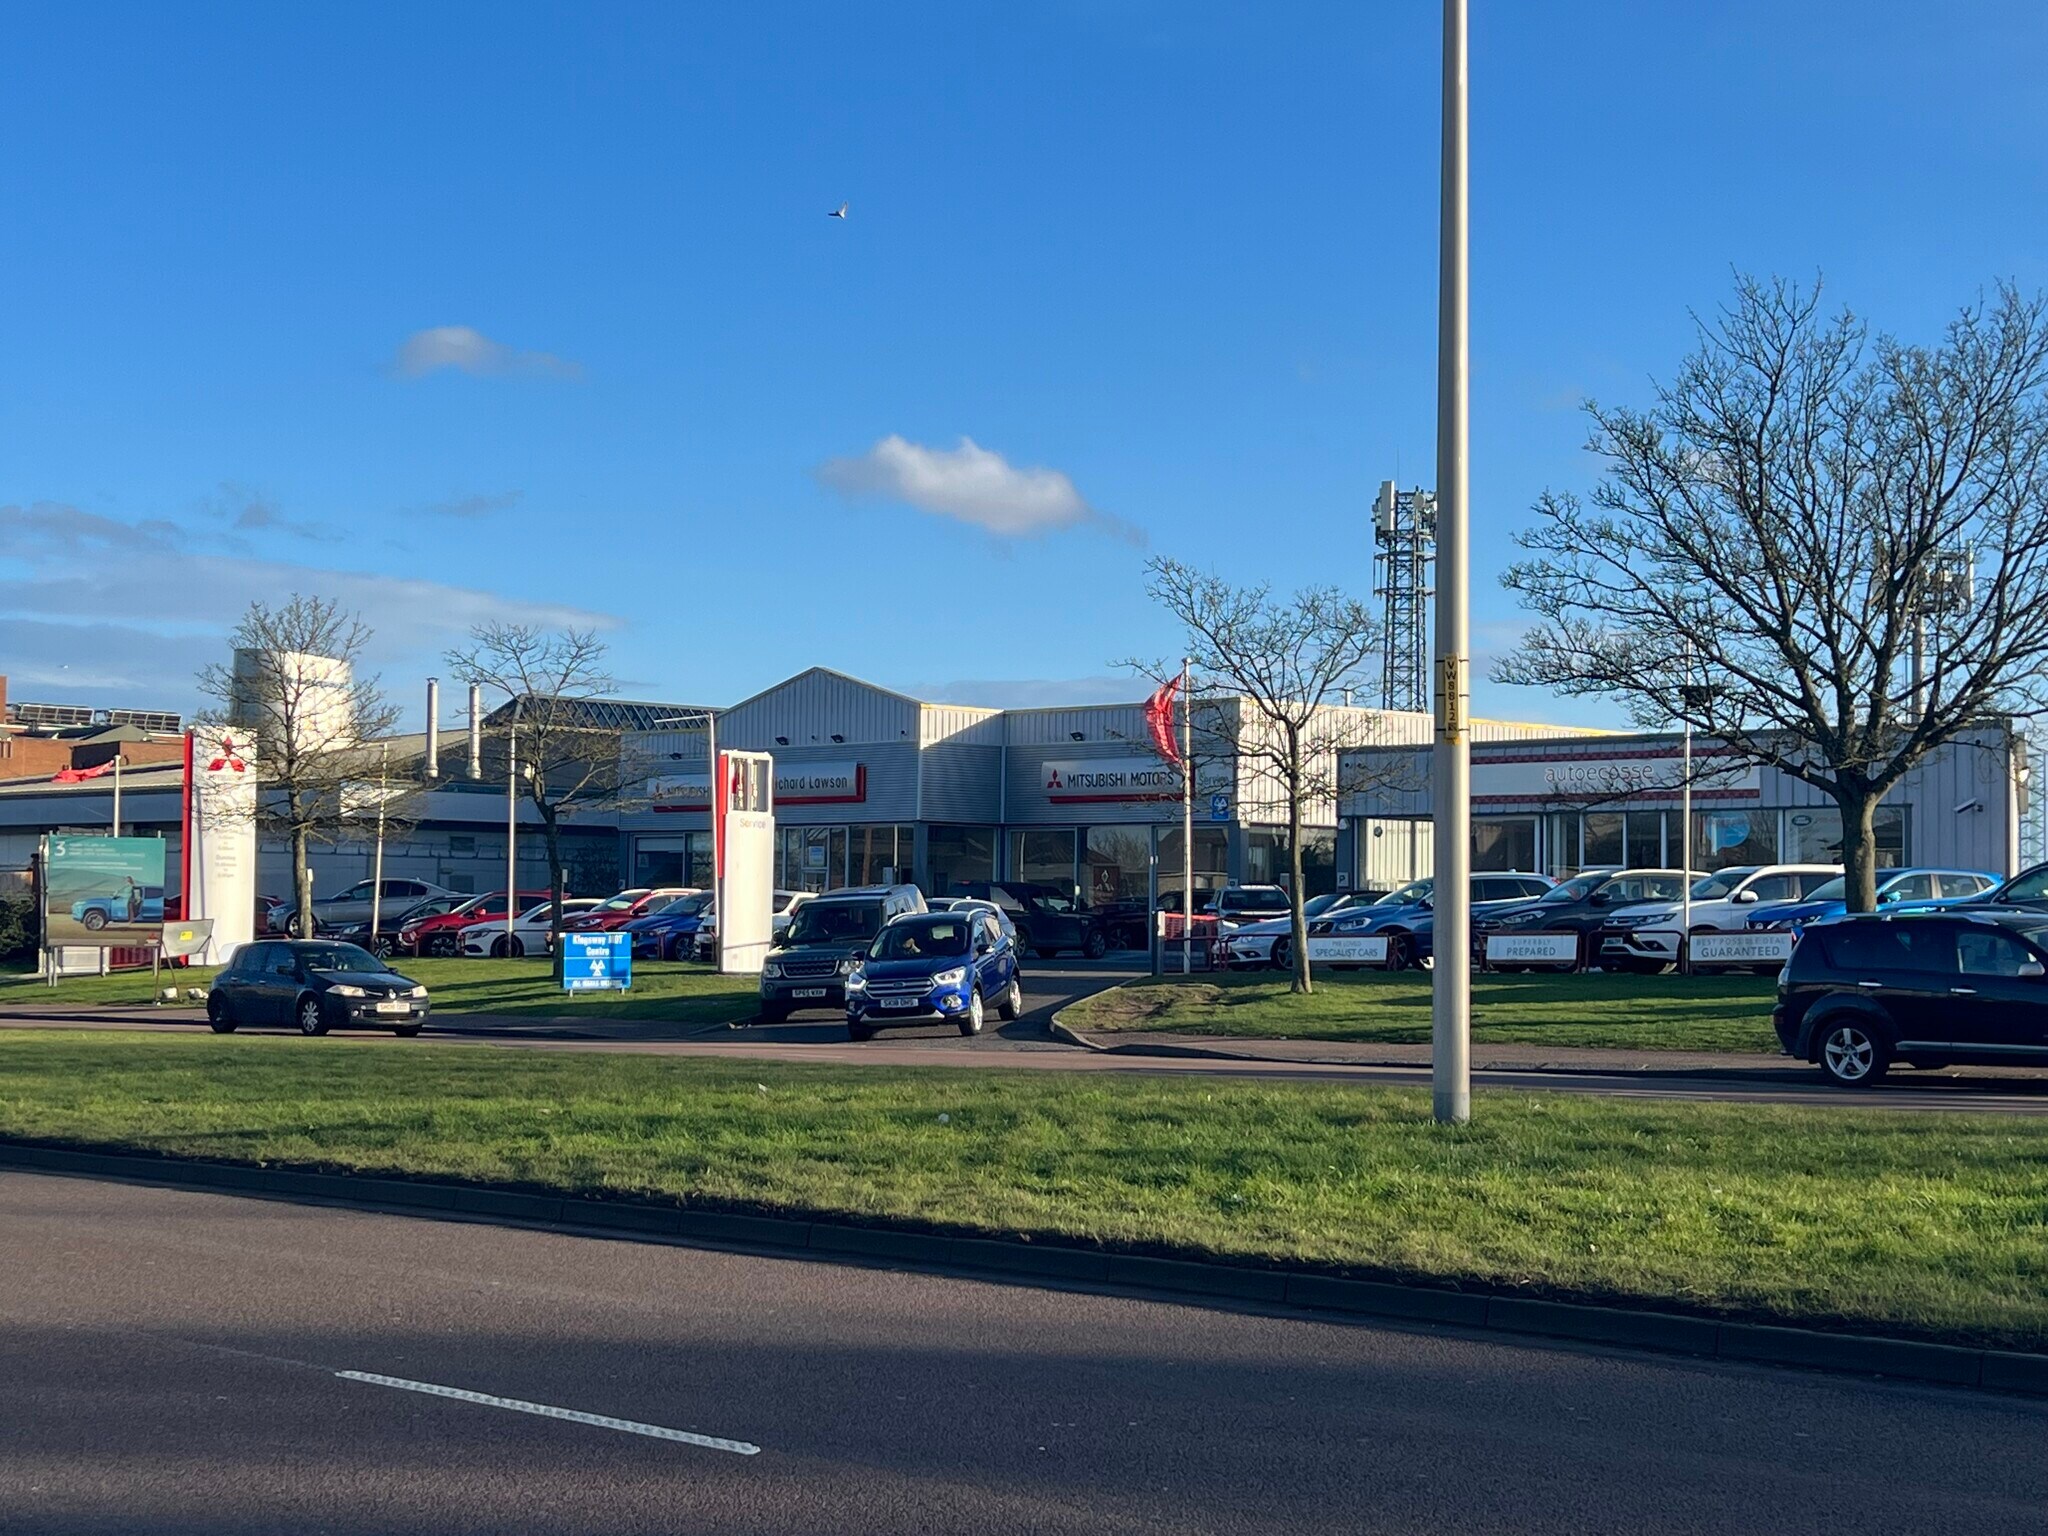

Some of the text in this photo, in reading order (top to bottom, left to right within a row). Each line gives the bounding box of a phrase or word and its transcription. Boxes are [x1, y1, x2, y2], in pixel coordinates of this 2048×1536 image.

[1067, 771, 1174, 788] MITSUBISHI MOTORS
[1544, 764, 1655, 784] autoecosse
[774, 776, 848, 790] ichard Lawson
[54, 840, 66, 857] 3
[1315, 948, 1378, 957] SPECIALIST CARS
[1506, 947, 1556, 956] PREPARED
[1701, 946, 1780, 958] GUARANTEED
